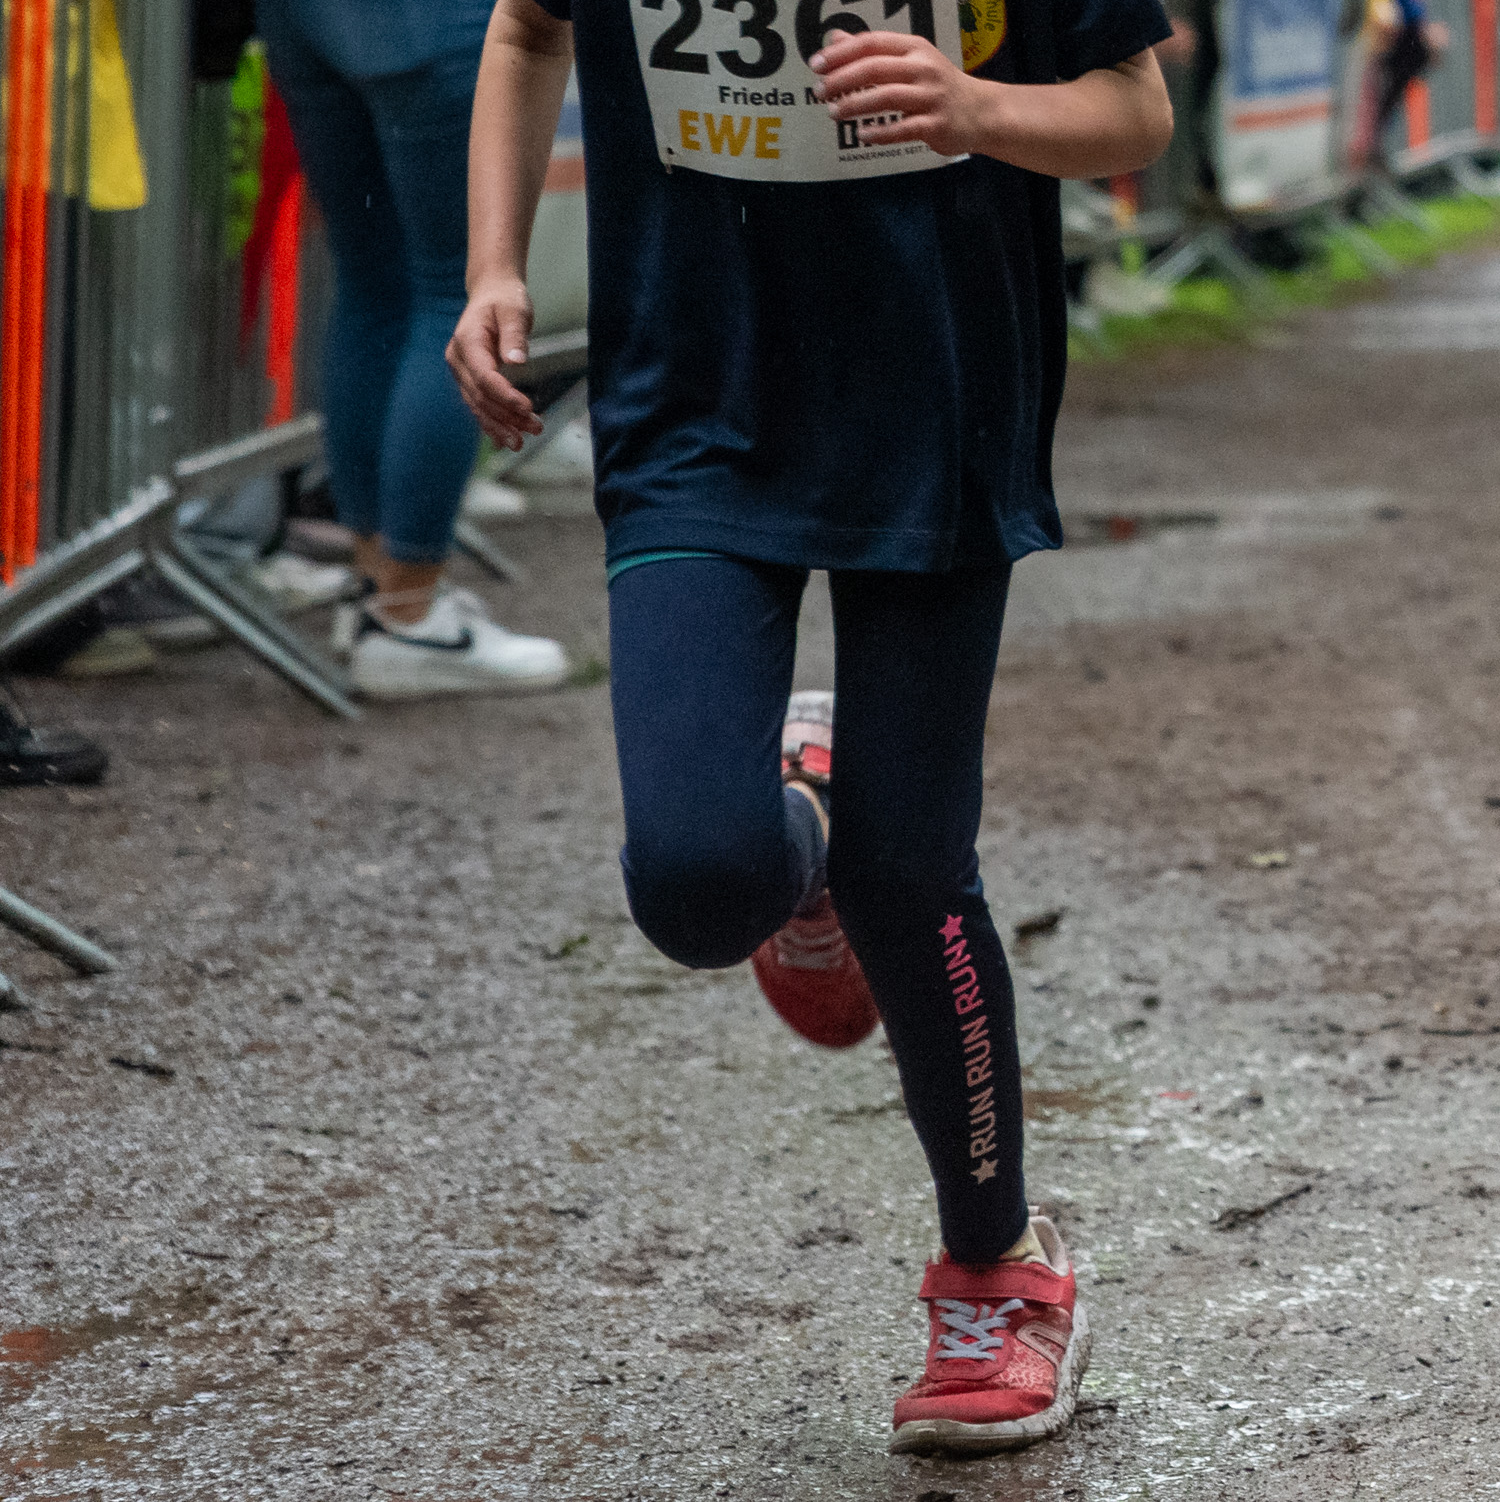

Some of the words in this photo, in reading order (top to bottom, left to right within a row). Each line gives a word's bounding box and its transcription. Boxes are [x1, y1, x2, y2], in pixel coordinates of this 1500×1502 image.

[718, 85, 796, 107] Frieda
[678, 108, 782, 160] EWE
[944, 938, 984, 1016] RUN
[961, 1015, 993, 1086] RUN
[969, 1086, 997, 1158] RUN
